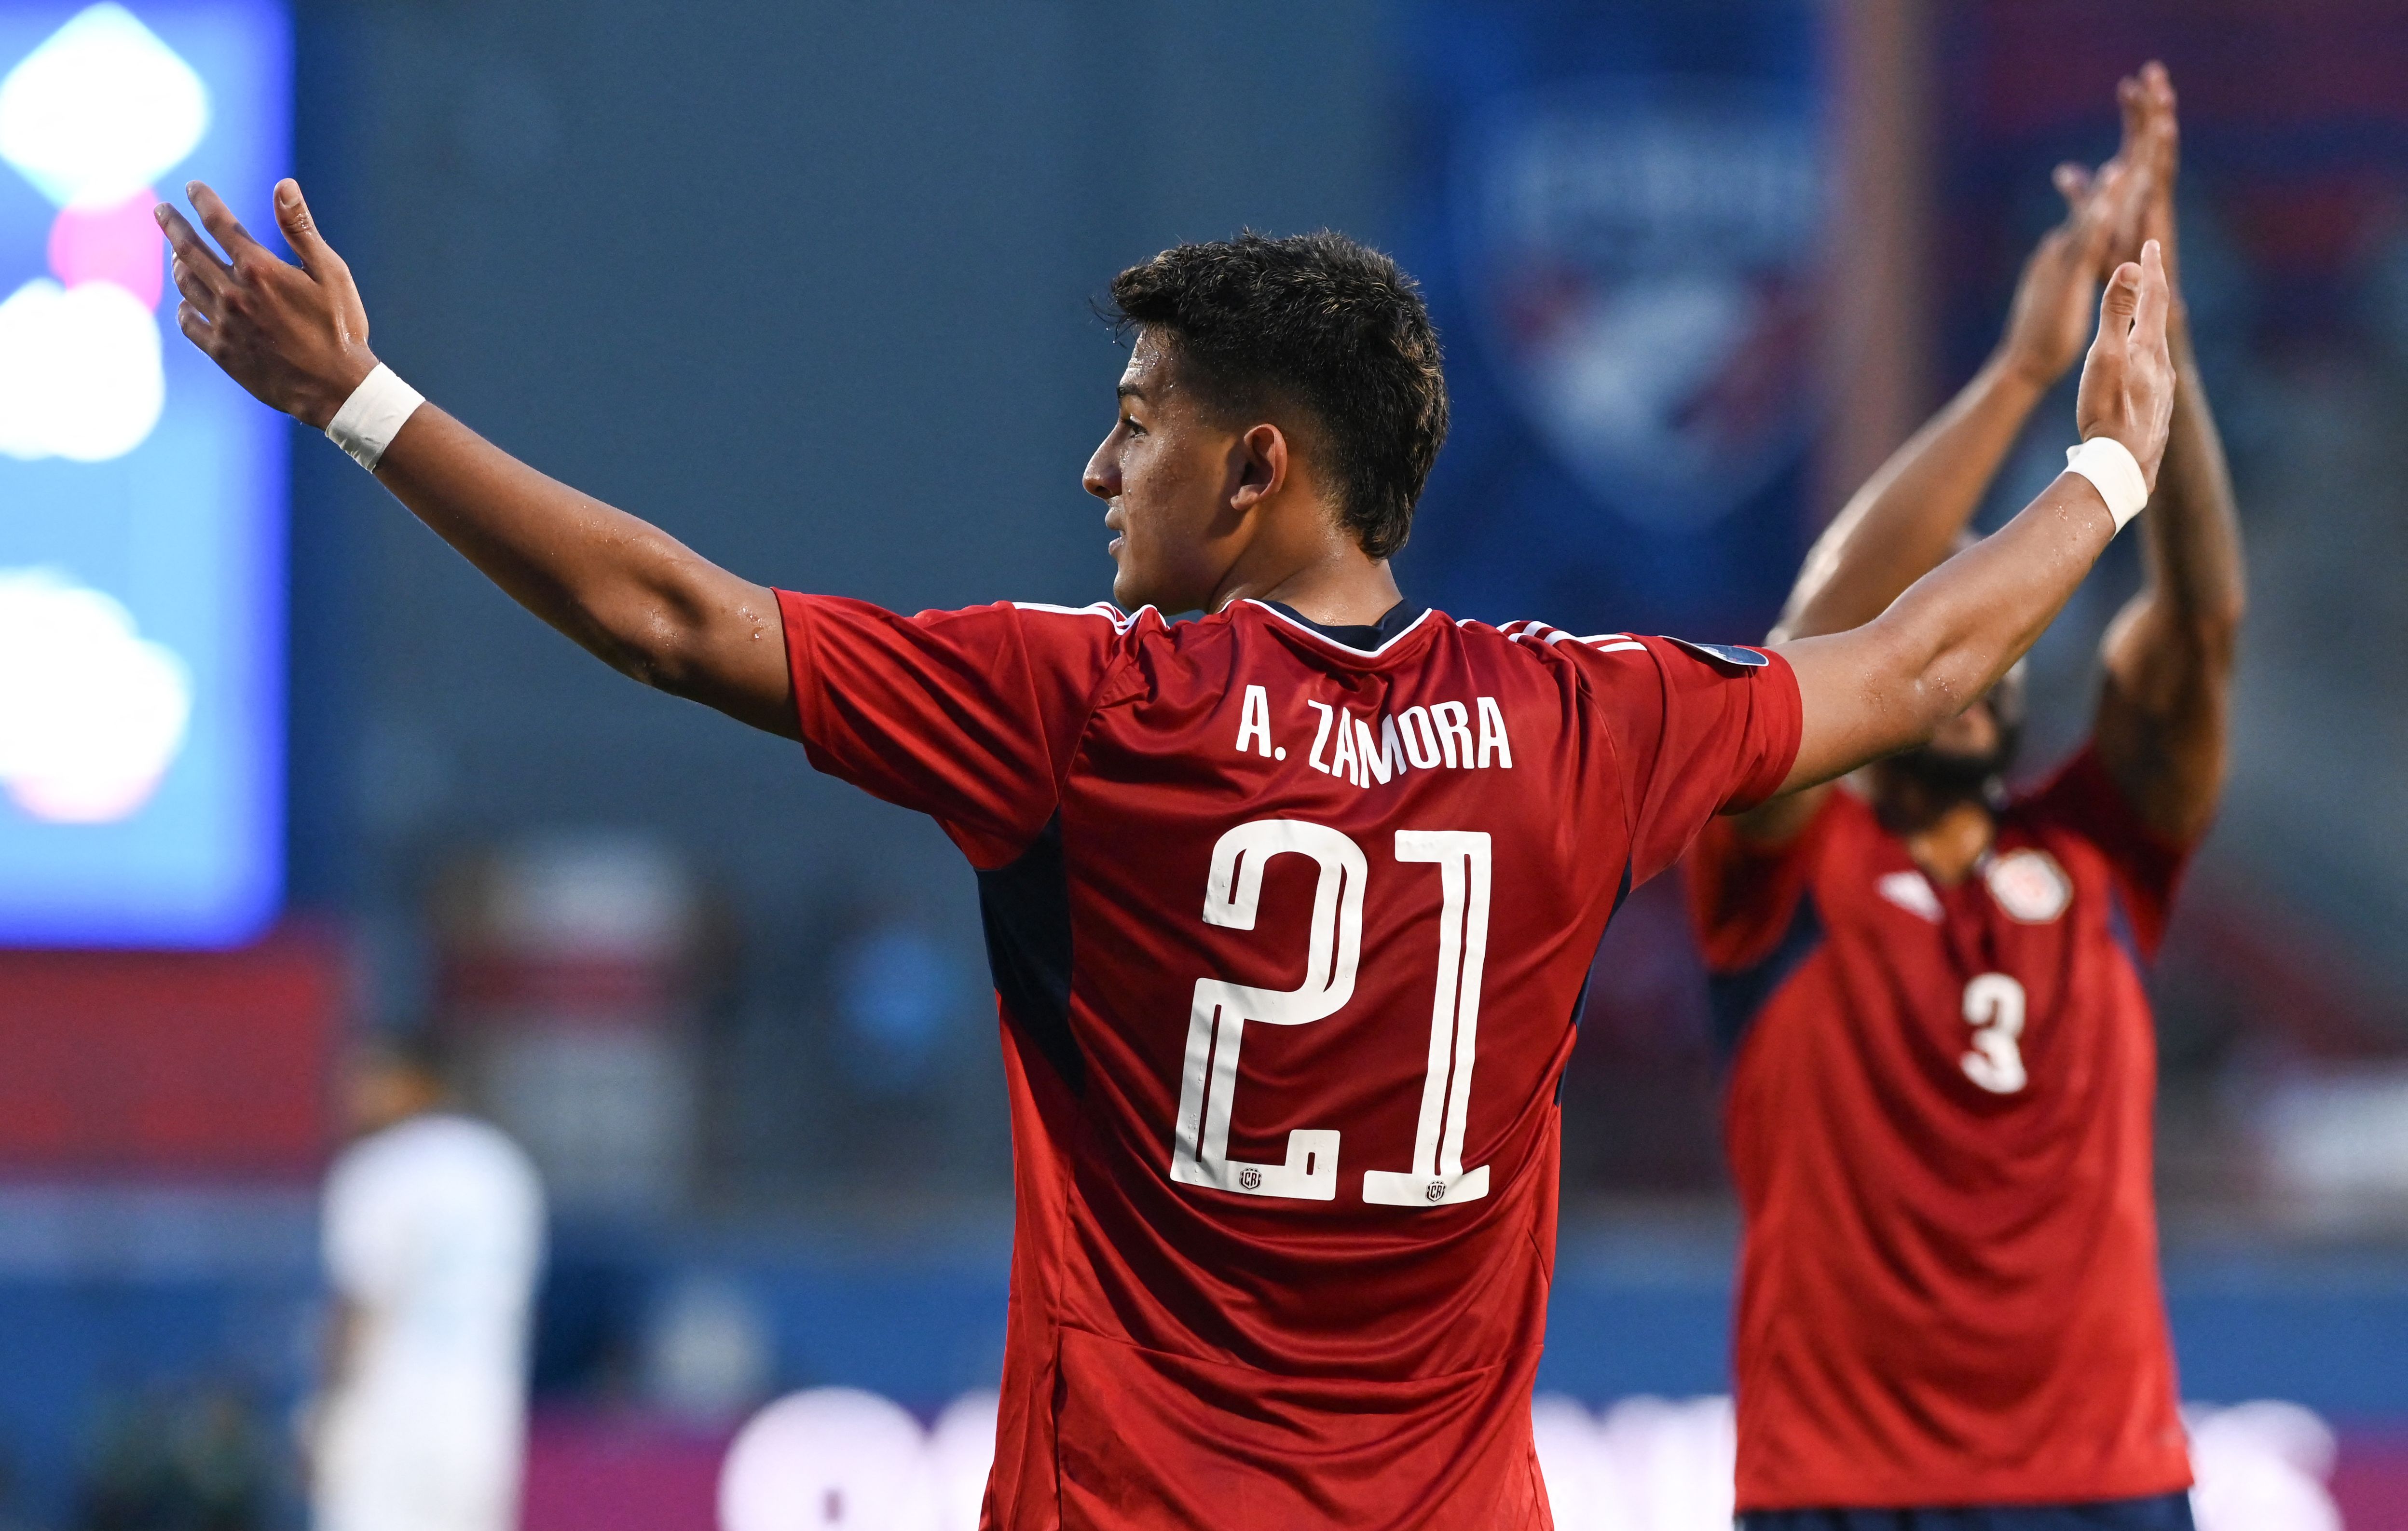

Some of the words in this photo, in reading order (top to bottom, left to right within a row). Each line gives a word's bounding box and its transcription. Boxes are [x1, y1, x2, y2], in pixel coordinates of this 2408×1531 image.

[1235, 684, 1286, 761] A.
[1307, 696, 1513, 789] ZAMORA
[1169, 819, 1491, 1207] 21
[1960, 972, 2027, 1094] 3
[1244, 1172, 1257, 1187] CR
[1430, 1185, 1442, 1199] CR
